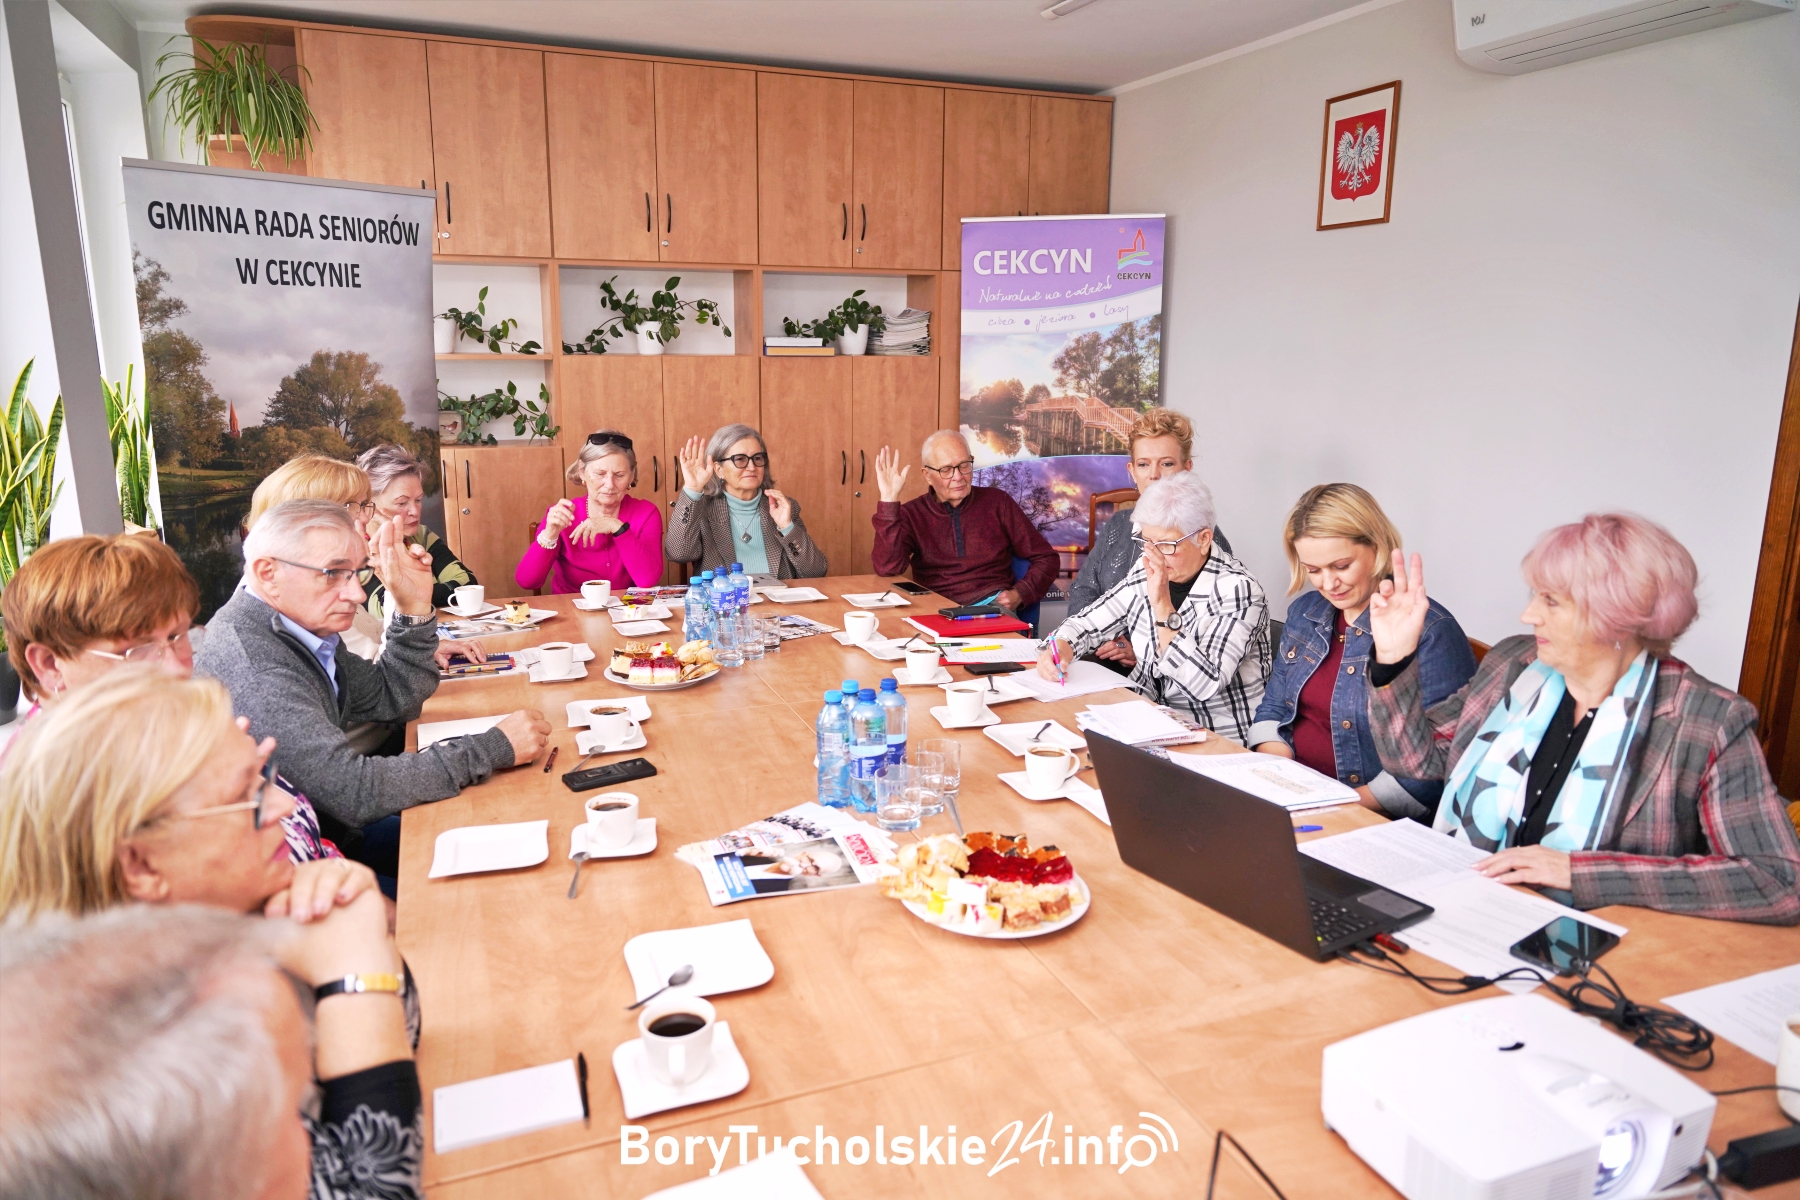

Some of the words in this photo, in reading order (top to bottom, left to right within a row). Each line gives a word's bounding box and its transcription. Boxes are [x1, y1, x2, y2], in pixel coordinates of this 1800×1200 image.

[147, 200, 250, 235] GMINNA
[254, 209, 315, 239] RADA
[318, 213, 420, 247] SENIORÓW
[235, 257, 259, 285] W
[265, 258, 362, 289] CEKCYNIE
[973, 248, 1093, 275] CEKCYN
[1116, 272, 1151, 280] CEKCYN
[979, 286, 1042, 303] Naturalnie
[1045, 291, 1062, 300] na
[988, 316, 1017, 327] cisza
[1035, 313, 1076, 333] jeziora
[1103, 303, 1129, 321] lasy
[1043, 589, 1065, 599] onie
